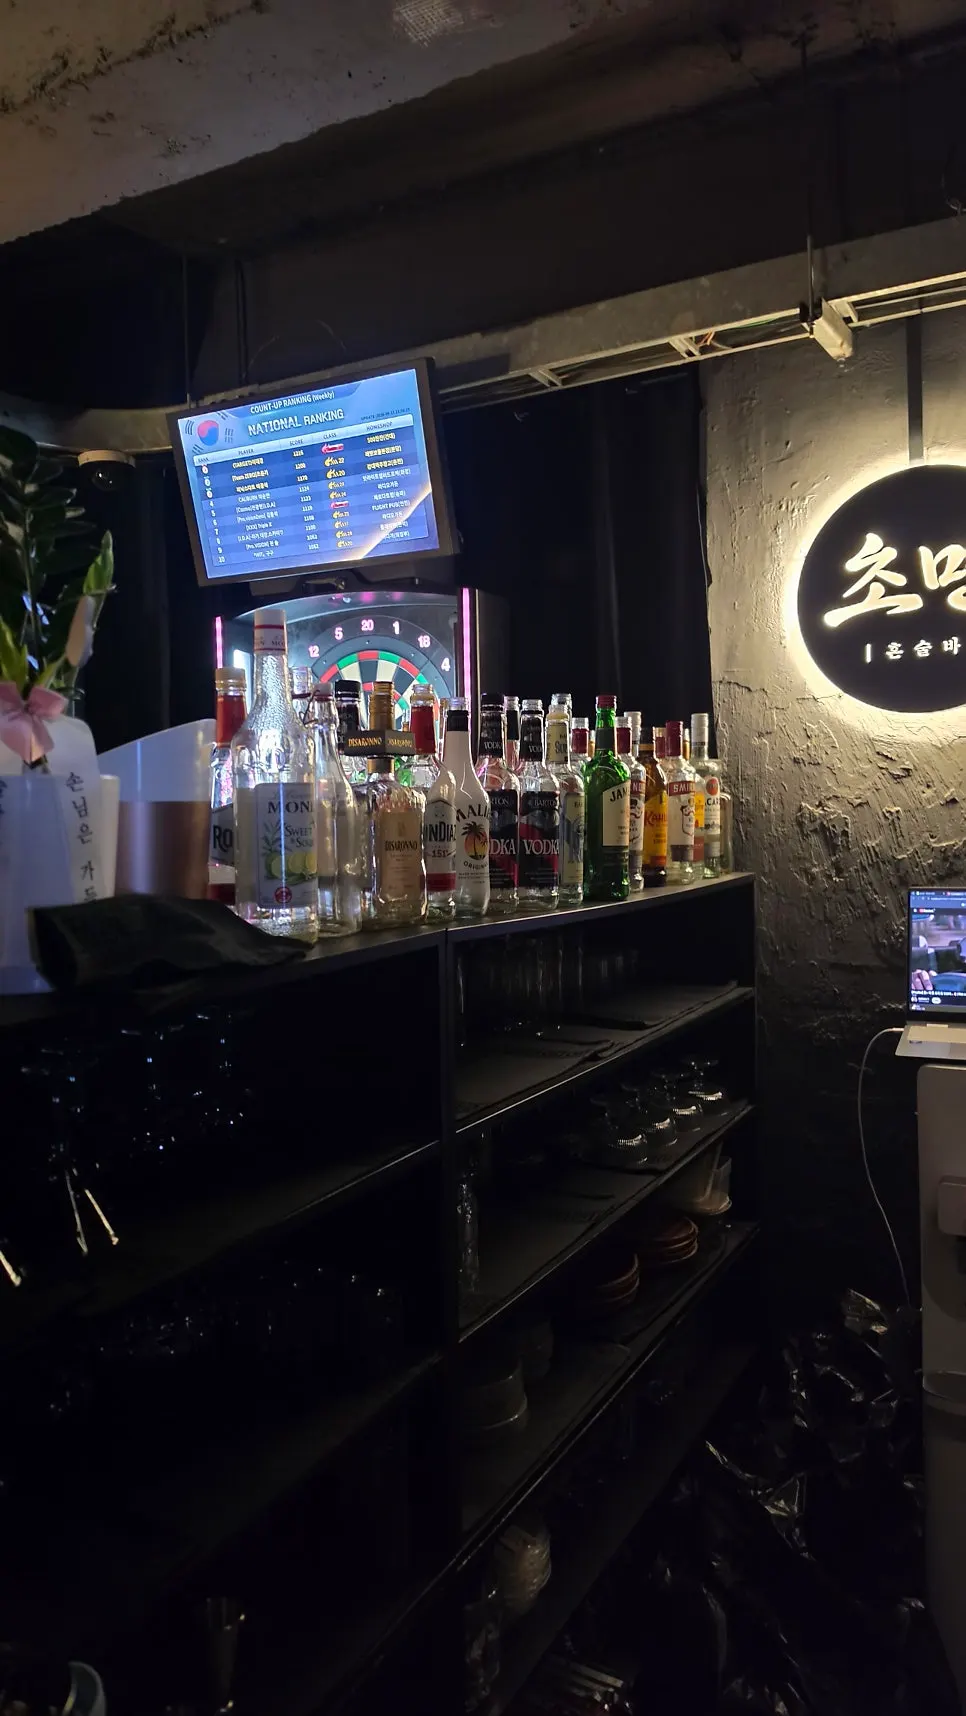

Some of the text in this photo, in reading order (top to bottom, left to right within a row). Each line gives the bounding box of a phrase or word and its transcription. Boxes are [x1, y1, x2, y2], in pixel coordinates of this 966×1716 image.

[250, 390, 335, 414] COUNT-UP RANKING (Weekly)
[248, 408, 345, 436] NATIONAL RANKING
[289, 438, 304, 447] SCORE
[308, 619, 451, 672] 12 5 20 1 18 4
[348, 737, 382, 748] DISARONNO
[66, 771, 94, 845] 손님은
[384, 840, 418, 852] DISARONNO
[489, 839, 517, 855] DKA
